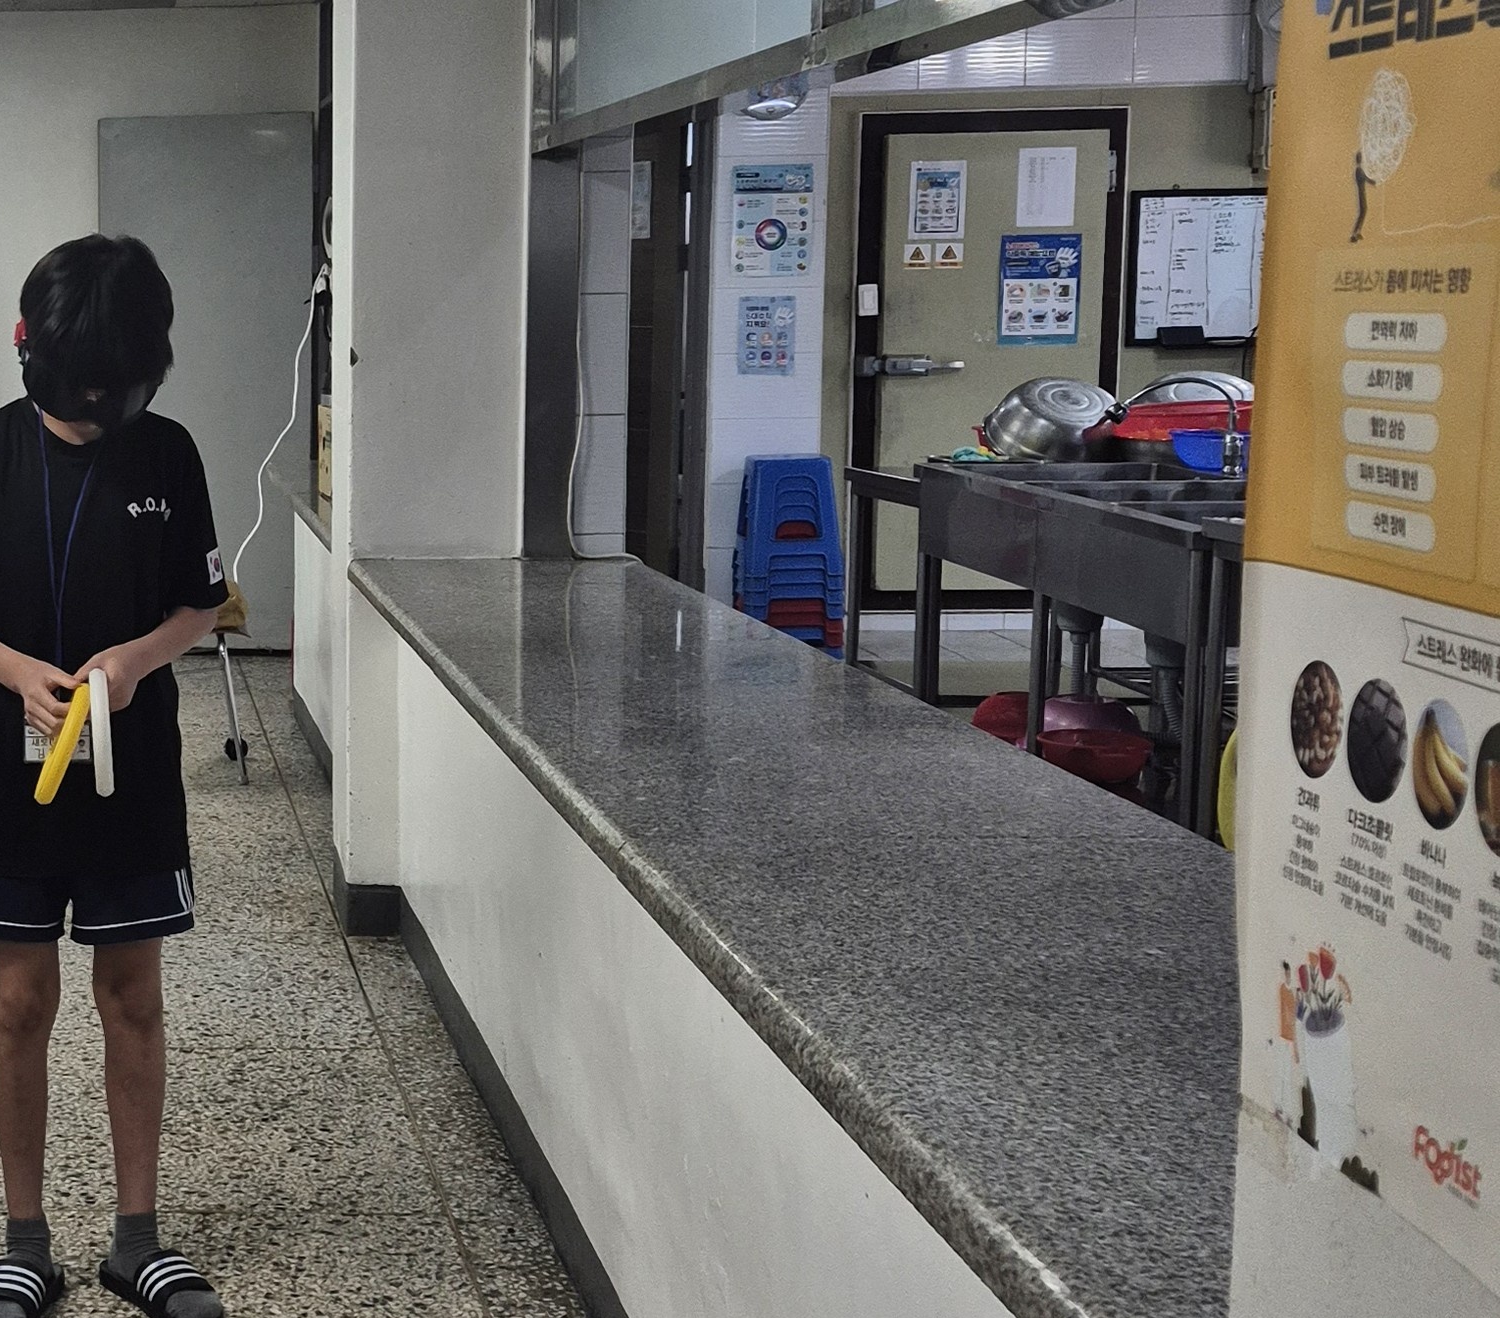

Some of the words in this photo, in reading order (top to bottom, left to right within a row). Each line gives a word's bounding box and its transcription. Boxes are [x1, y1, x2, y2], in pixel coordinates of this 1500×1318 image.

[1334, 269, 1384, 293] 스트레스가
[1386, 268, 1409, 294] 몸에
[1411, 268, 1444, 294] 미치는
[1447, 267, 1472, 294] 영향
[1371, 320, 1398, 341] 면역력
[1367, 368, 1394, 391] 소화기
[1388, 419, 1406, 441] 상승
[1417, 634, 1457, 666] 스트레스
[1460, 644, 1493, 679] 완화에
[1348, 808, 1394, 844] 다크초콜릿
[1420, 839, 1447, 870] 바나나
